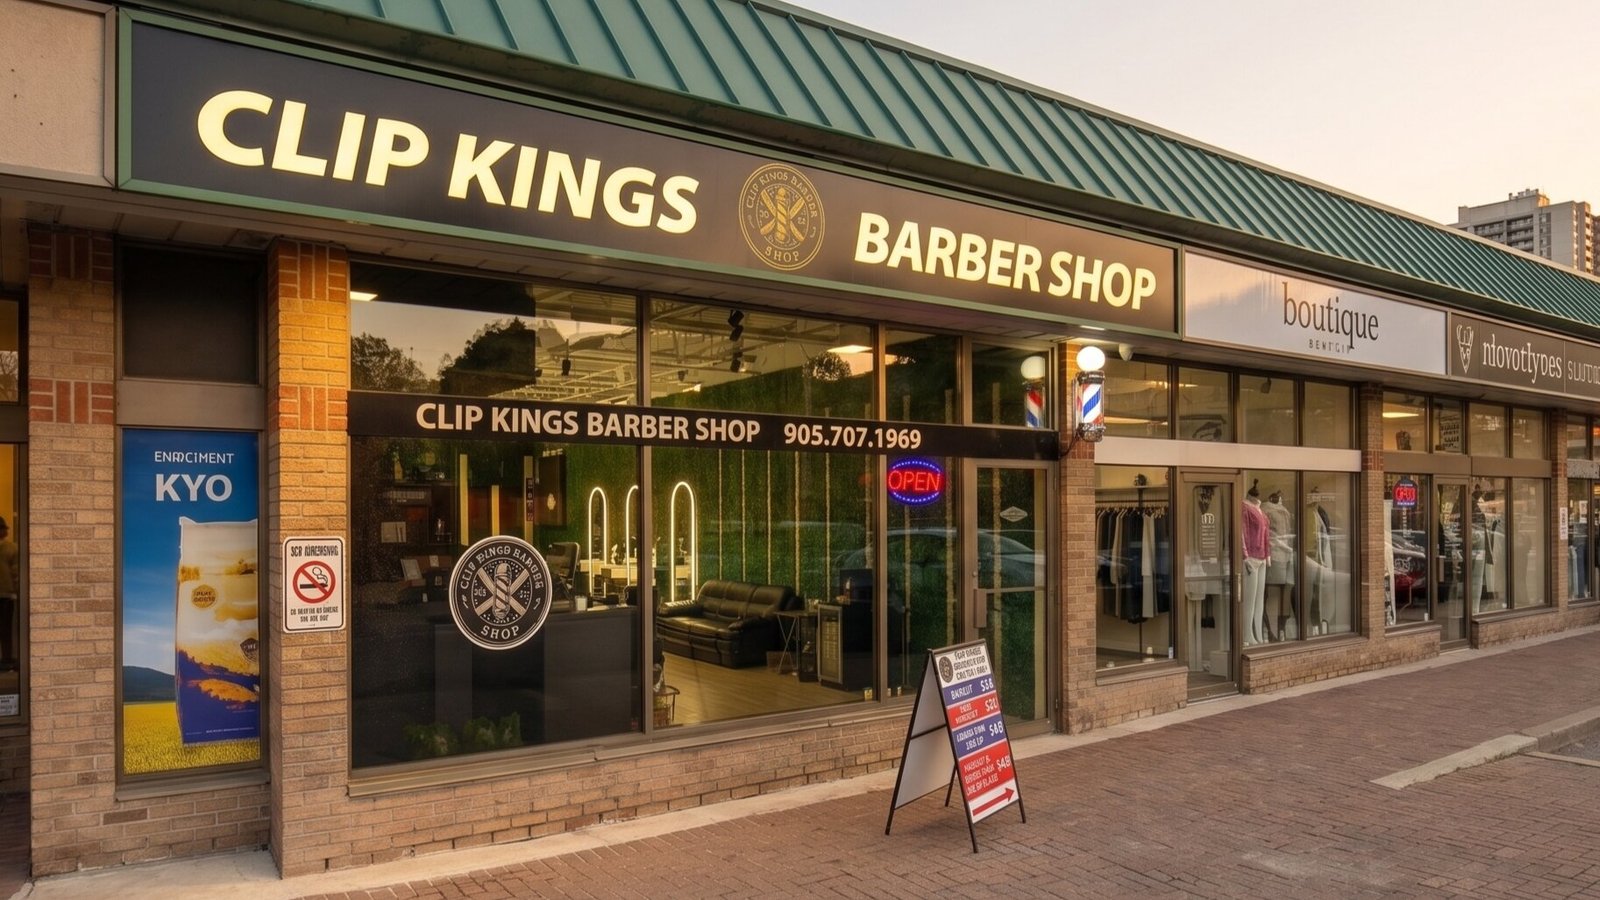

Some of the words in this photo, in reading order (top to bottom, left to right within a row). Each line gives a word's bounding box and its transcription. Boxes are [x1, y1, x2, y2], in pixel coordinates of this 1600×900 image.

[197, 90, 430, 187] CLIP
[447, 132, 700, 235] KINGS
[764, 246, 800, 262] SHOP
[854, 211, 1041, 293] BARBER
[1047, 249, 1157, 311] SHOP
[1282, 281, 1379, 350] boutique
[415, 402, 484, 432] CLIP
[491, 406, 580, 437] KINGS
[586, 412, 691, 441] BARBER
[694, 417, 761, 443] SHOP
[783, 422, 922, 450] 905.707.1969
[155, 473, 233, 502] KYO
[888, 470, 941, 491] OPEN
[480, 624, 520, 640] SHOP
